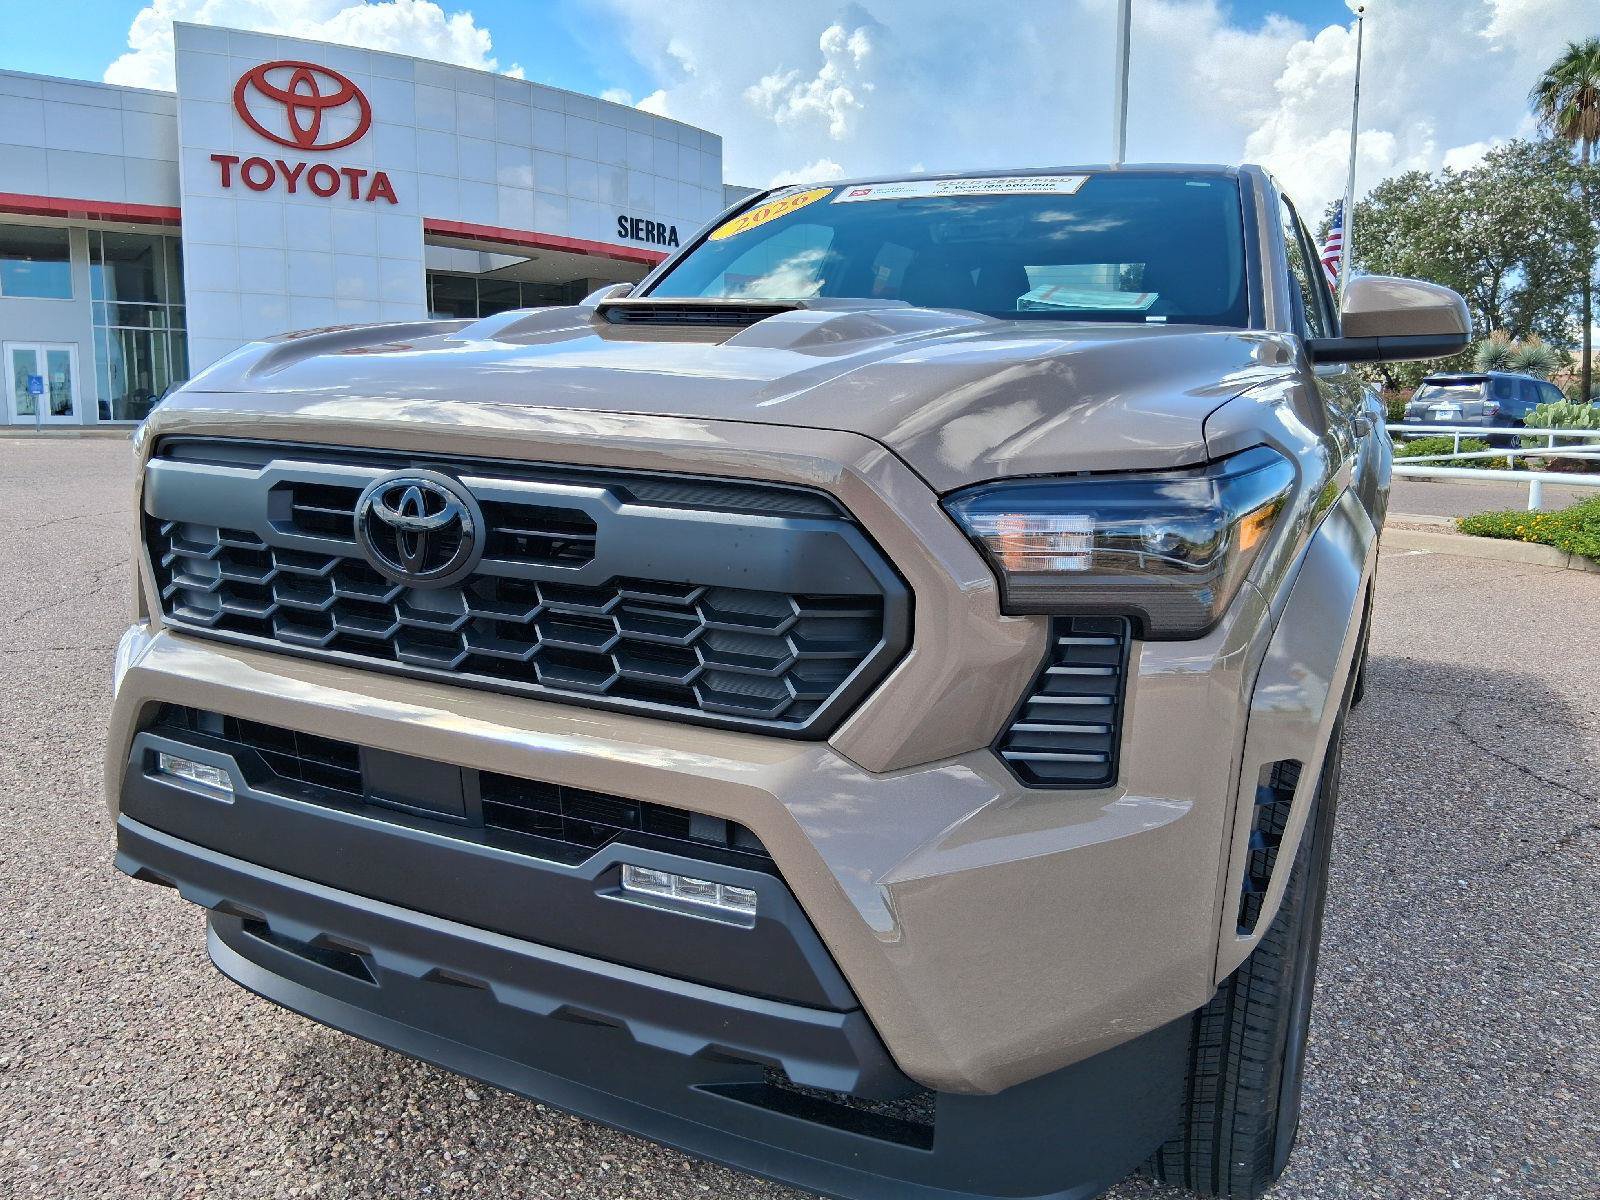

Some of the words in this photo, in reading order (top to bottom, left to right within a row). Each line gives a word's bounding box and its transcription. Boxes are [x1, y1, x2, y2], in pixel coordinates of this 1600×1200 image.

[210, 154, 398, 204] TOYOTA
[617, 215, 680, 248] SIERRA
[734, 194, 809, 233] 2026
